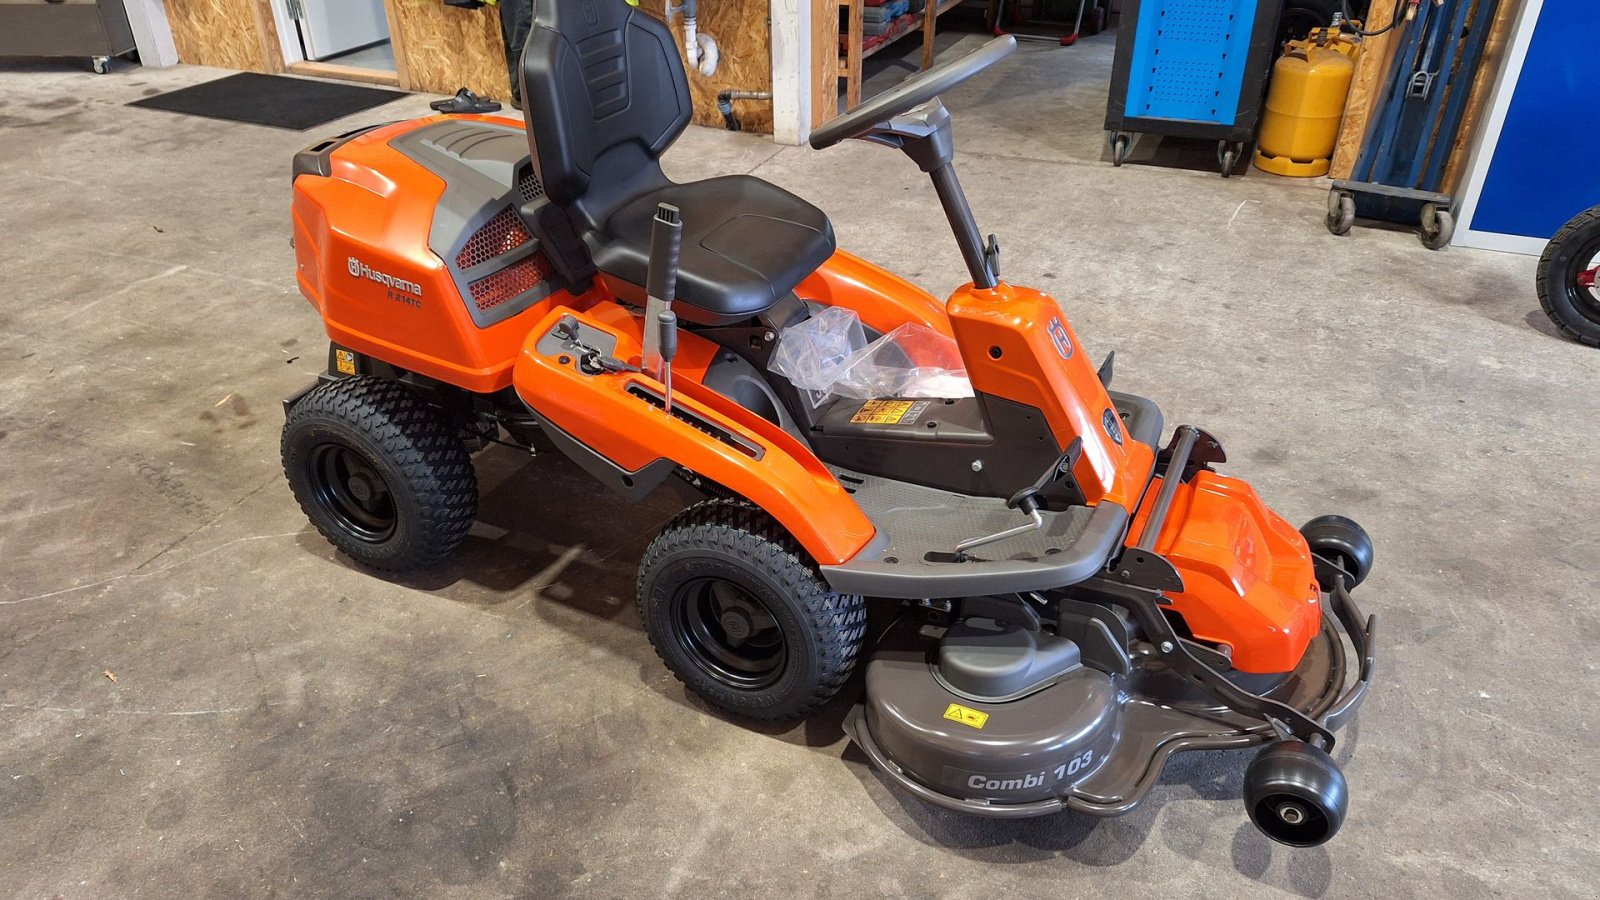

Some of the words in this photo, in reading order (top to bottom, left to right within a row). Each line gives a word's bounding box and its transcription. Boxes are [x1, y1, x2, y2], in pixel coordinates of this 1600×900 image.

[360, 262, 422, 296] Husqvarna
[387, 290, 394, 299] R
[395, 294, 422, 308] 214TC
[967, 771, 1047, 790] Combi
[1054, 749, 1093, 780] 103
